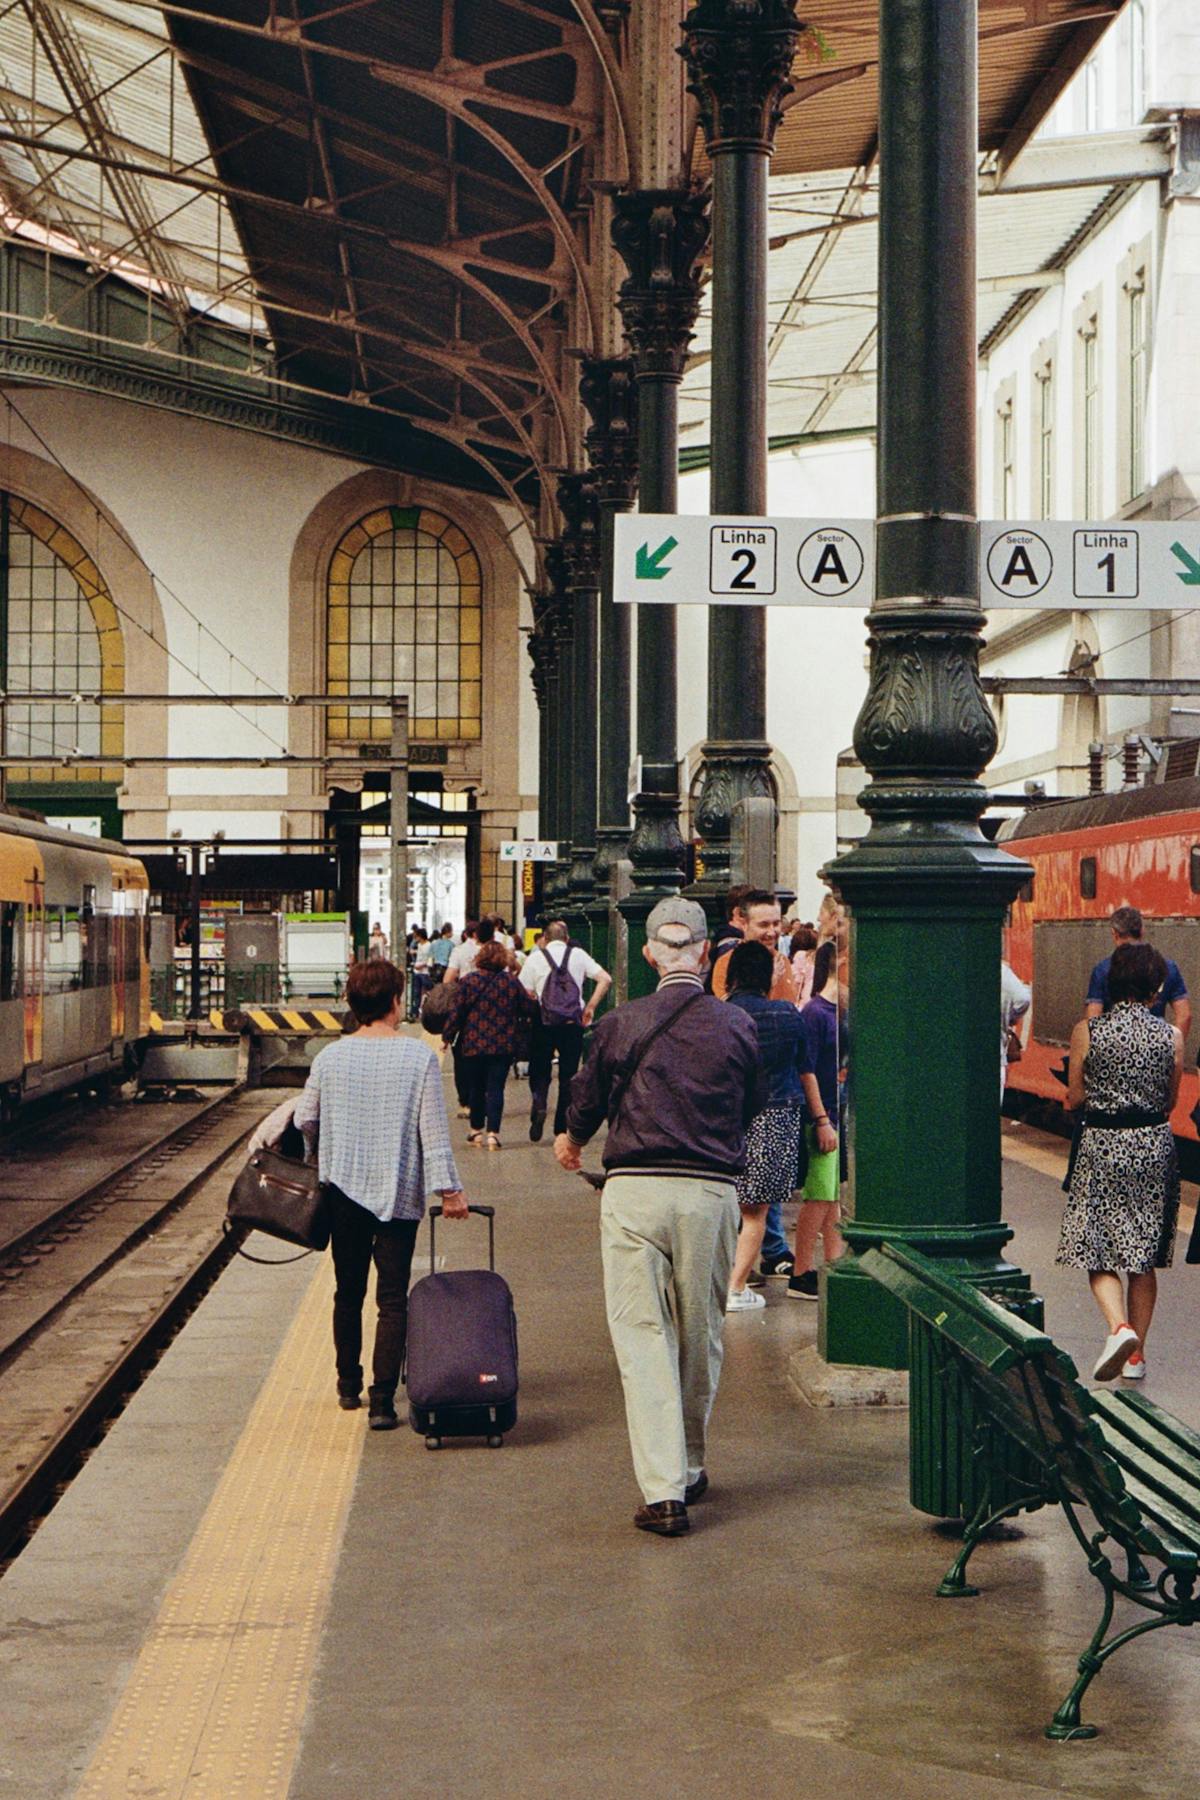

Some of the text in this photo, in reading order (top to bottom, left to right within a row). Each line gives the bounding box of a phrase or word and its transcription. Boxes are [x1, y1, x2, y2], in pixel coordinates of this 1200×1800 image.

[722, 530, 766, 544] Linha
[817, 534, 844, 544] Sector
[1006, 536, 1033, 545] Sector
[1083, 534, 1128, 548] Linha
[730, 549, 757, 590] 2
[812, 544, 848, 584] A
[1002, 546, 1039, 586] A
[1098, 552, 1115, 593] 1
[368, 747, 440, 761] ENADA
